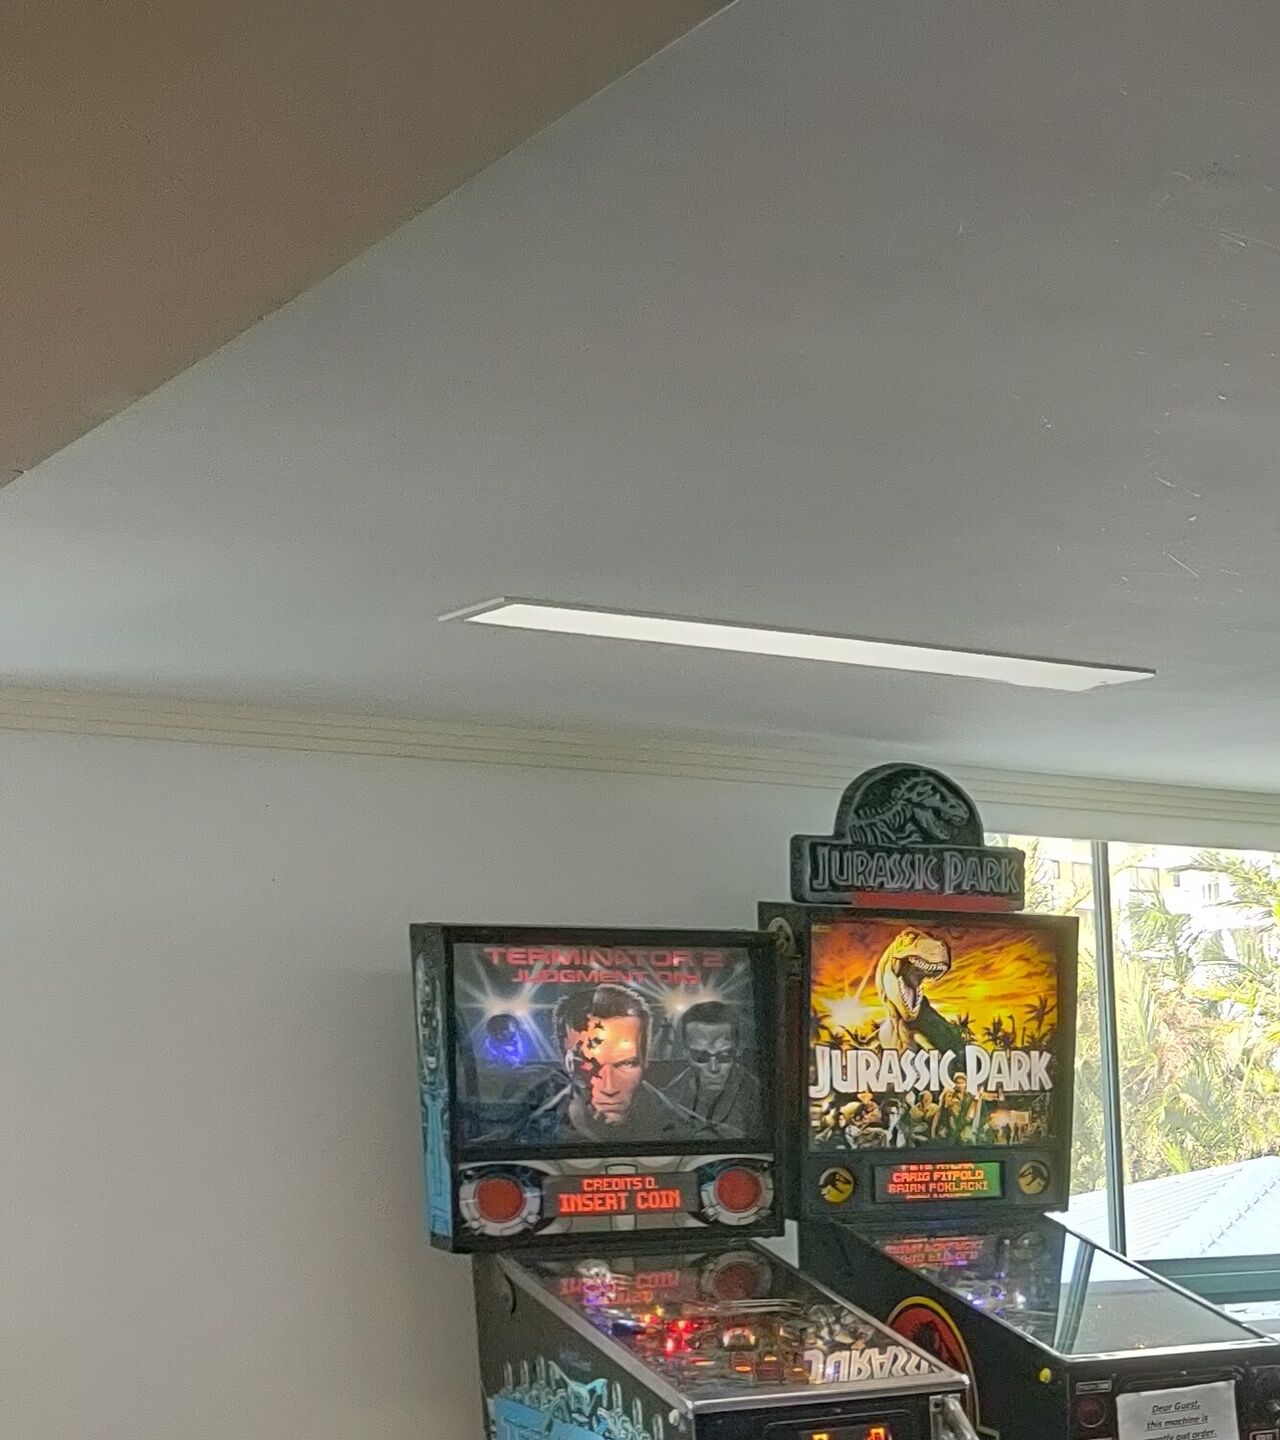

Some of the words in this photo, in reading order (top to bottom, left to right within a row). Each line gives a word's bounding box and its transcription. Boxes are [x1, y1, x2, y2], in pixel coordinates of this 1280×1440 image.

[813, 845, 944, 891] JURASSIC
[943, 850, 1021, 895] PARK
[483, 947, 694, 967] TERMINATOR
[702, 949, 727, 967] 2
[512, 968, 645, 984] JUDGMENT
[809, 1045, 957, 1099] JURASSIC
[965, 1044, 1053, 1096] PARK
[582, 1177, 641, 1191] CREDITS
[559, 1192, 629, 1213] INSERT
[636, 1189, 682, 1210] COIN
[1151, 1402, 1172, 1414] Dear
[1146, 1420, 1162, 1430] this
[1164, 1416, 1200, 1428] machine
